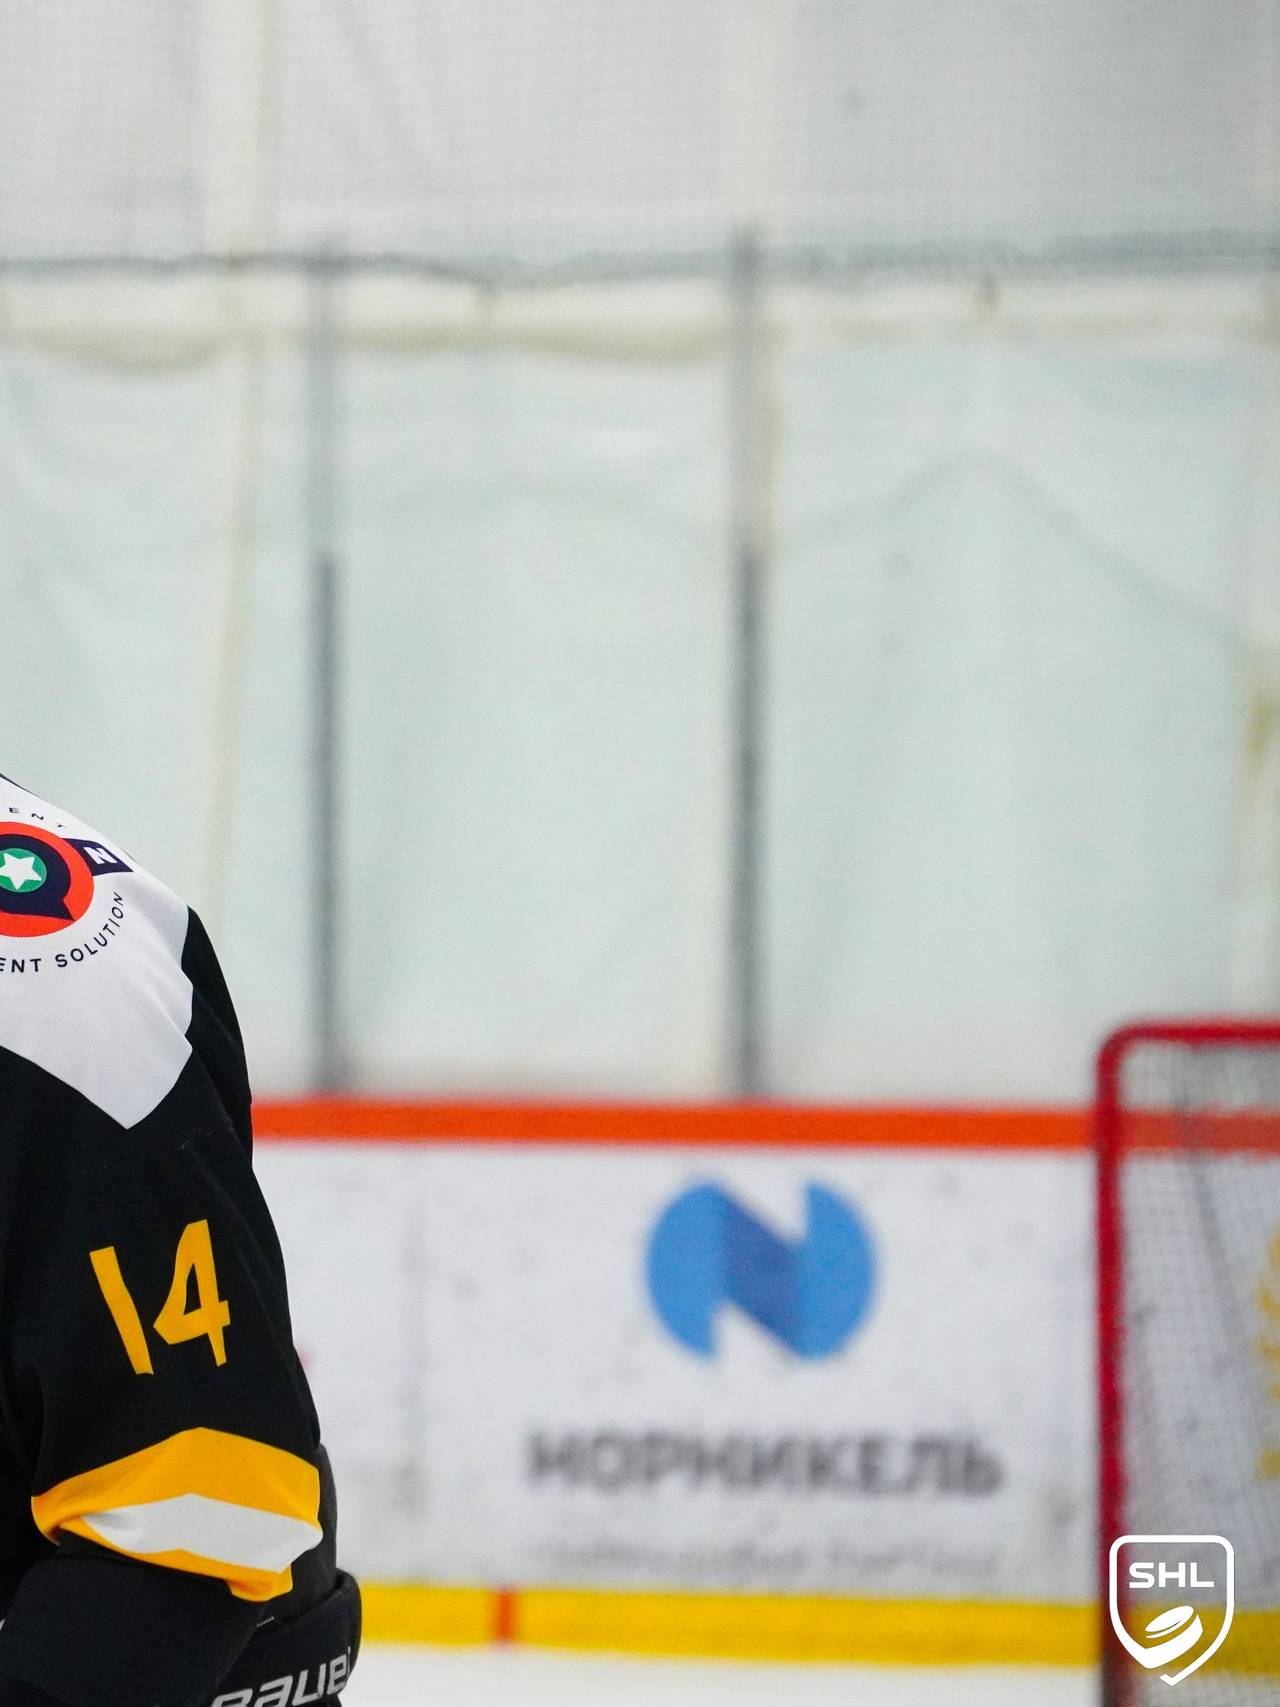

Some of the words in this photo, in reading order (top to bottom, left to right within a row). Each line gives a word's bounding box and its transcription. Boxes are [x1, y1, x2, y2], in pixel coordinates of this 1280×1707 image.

[54, 891, 125, 968] SOLUTION
[90, 1219, 231, 1375] 14
[526, 1428, 1007, 1496] НОРНИКЕЛЬ
[210, 1646, 351, 1707] AUE
